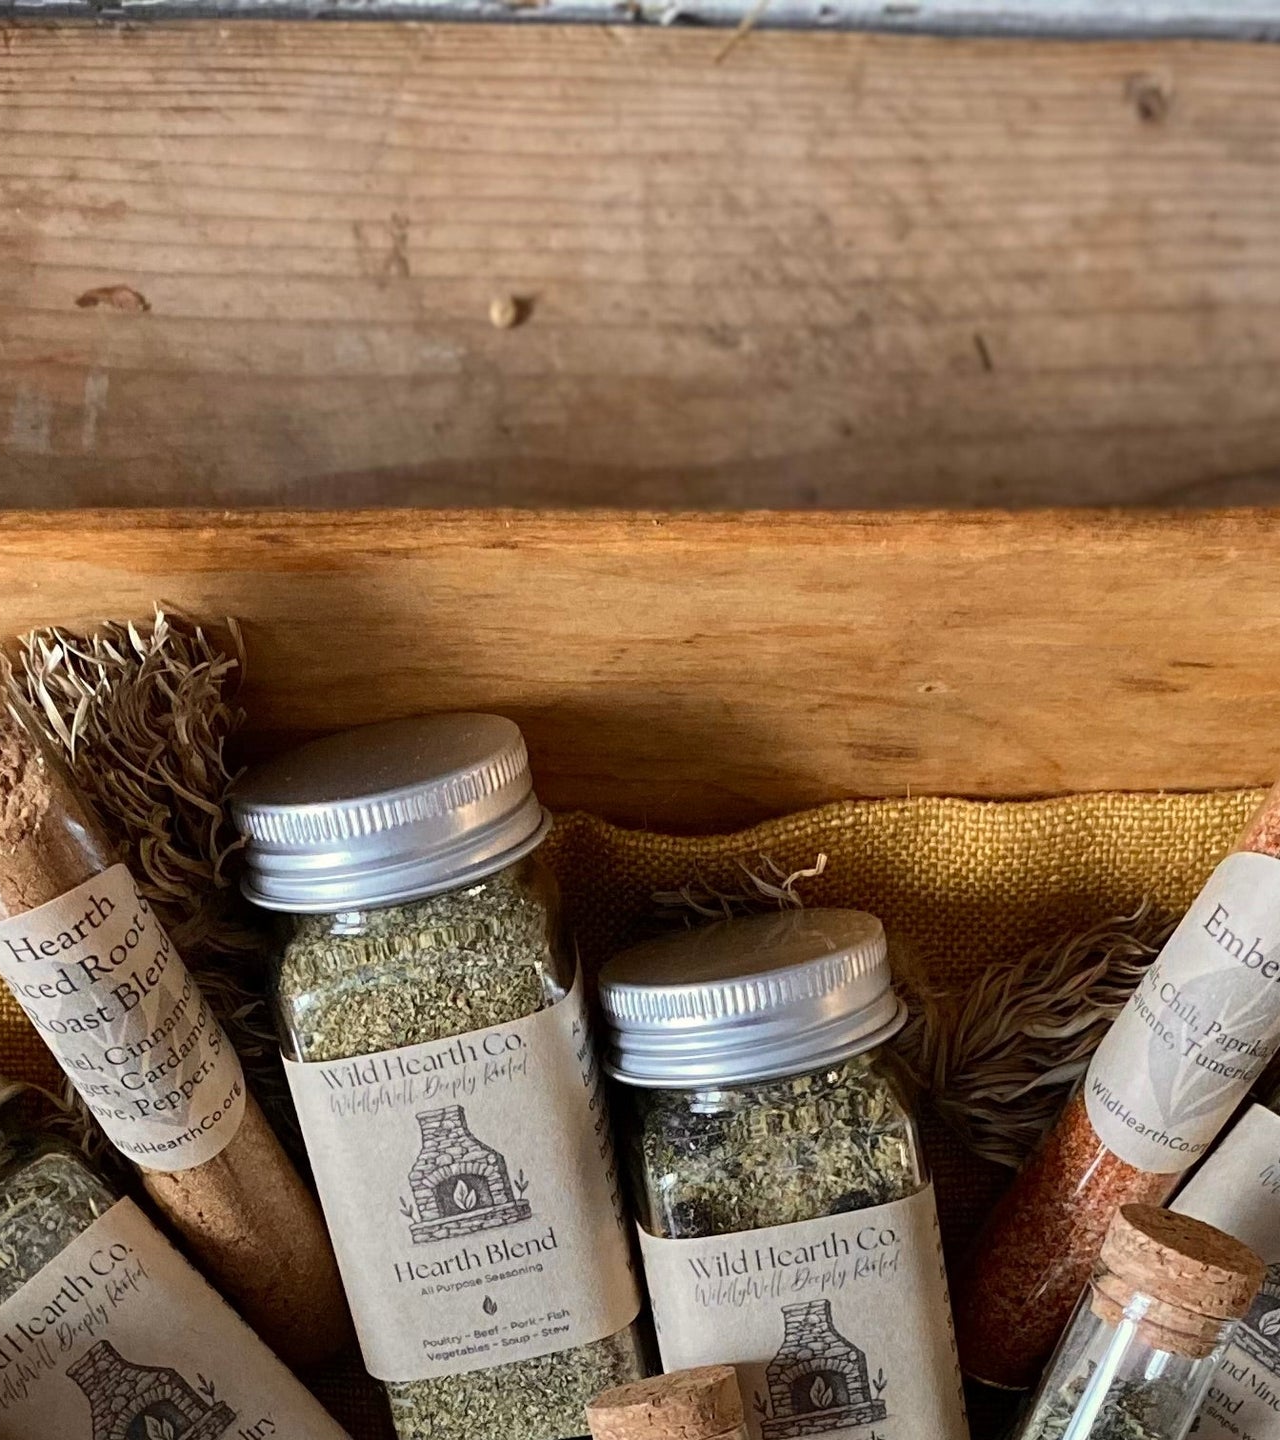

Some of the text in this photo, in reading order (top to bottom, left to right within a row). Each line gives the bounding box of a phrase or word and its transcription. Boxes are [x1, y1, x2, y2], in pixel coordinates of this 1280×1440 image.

[3, 893, 115, 964] Hearth
[77, 917, 145, 985] Root
[27, 922, 169, 1035] Roast Blend
[1160, 981, 1200, 1031] Chili,
[320, 1032, 527, 1091] Wild Hearth Co.
[133, 1062, 216, 1122] Pepper,
[394, 1228, 558, 1283] Hearth Blend
[421, 1263, 543, 1296] All Purpose Seasoning
[689, 1226, 900, 1280] Wild Hearth Co.
[6, 1271, 93, 1356] Hearth
[88, 1242, 133, 1276] Co.
[423, 1309, 570, 1348] Poultry Beef Pork Fish
[427, 1324, 570, 1361] Vegetables Soup Stew
